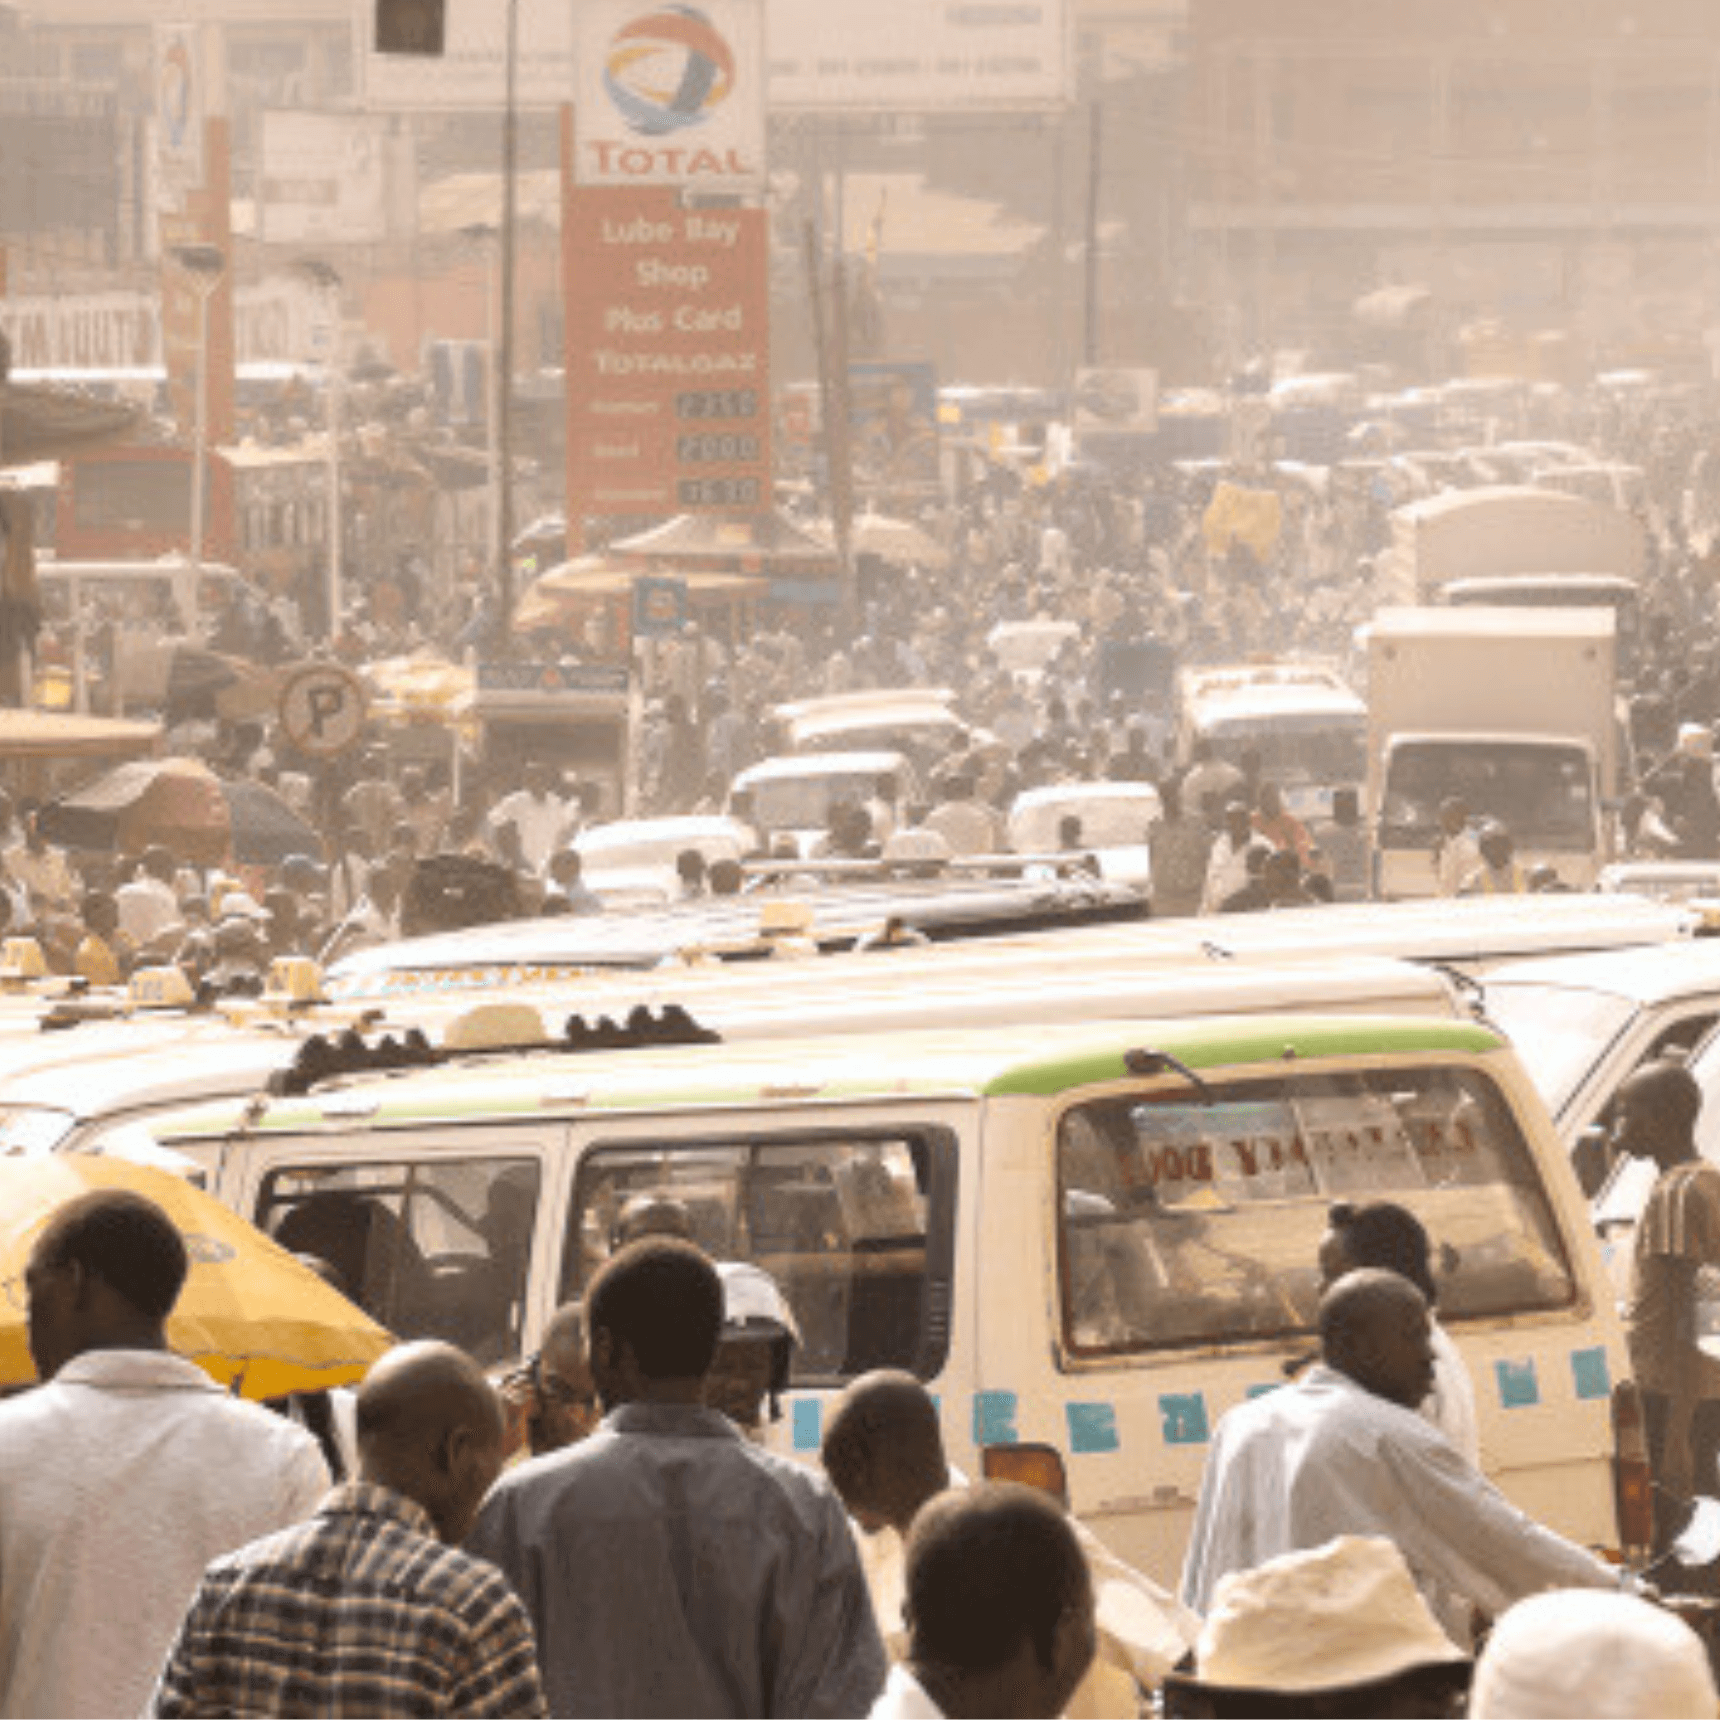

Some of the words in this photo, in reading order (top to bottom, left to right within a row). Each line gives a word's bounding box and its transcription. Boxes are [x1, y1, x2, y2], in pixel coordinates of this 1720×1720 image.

[586, 139, 755, 175] TOTAL
[602, 216, 674, 243] Lube
[685, 216, 740, 247] Bay
[636, 260, 710, 289] Shop
[604, 306, 663, 332] Plus
[673, 304, 743, 332] Card
[307, 685, 343, 738] P
